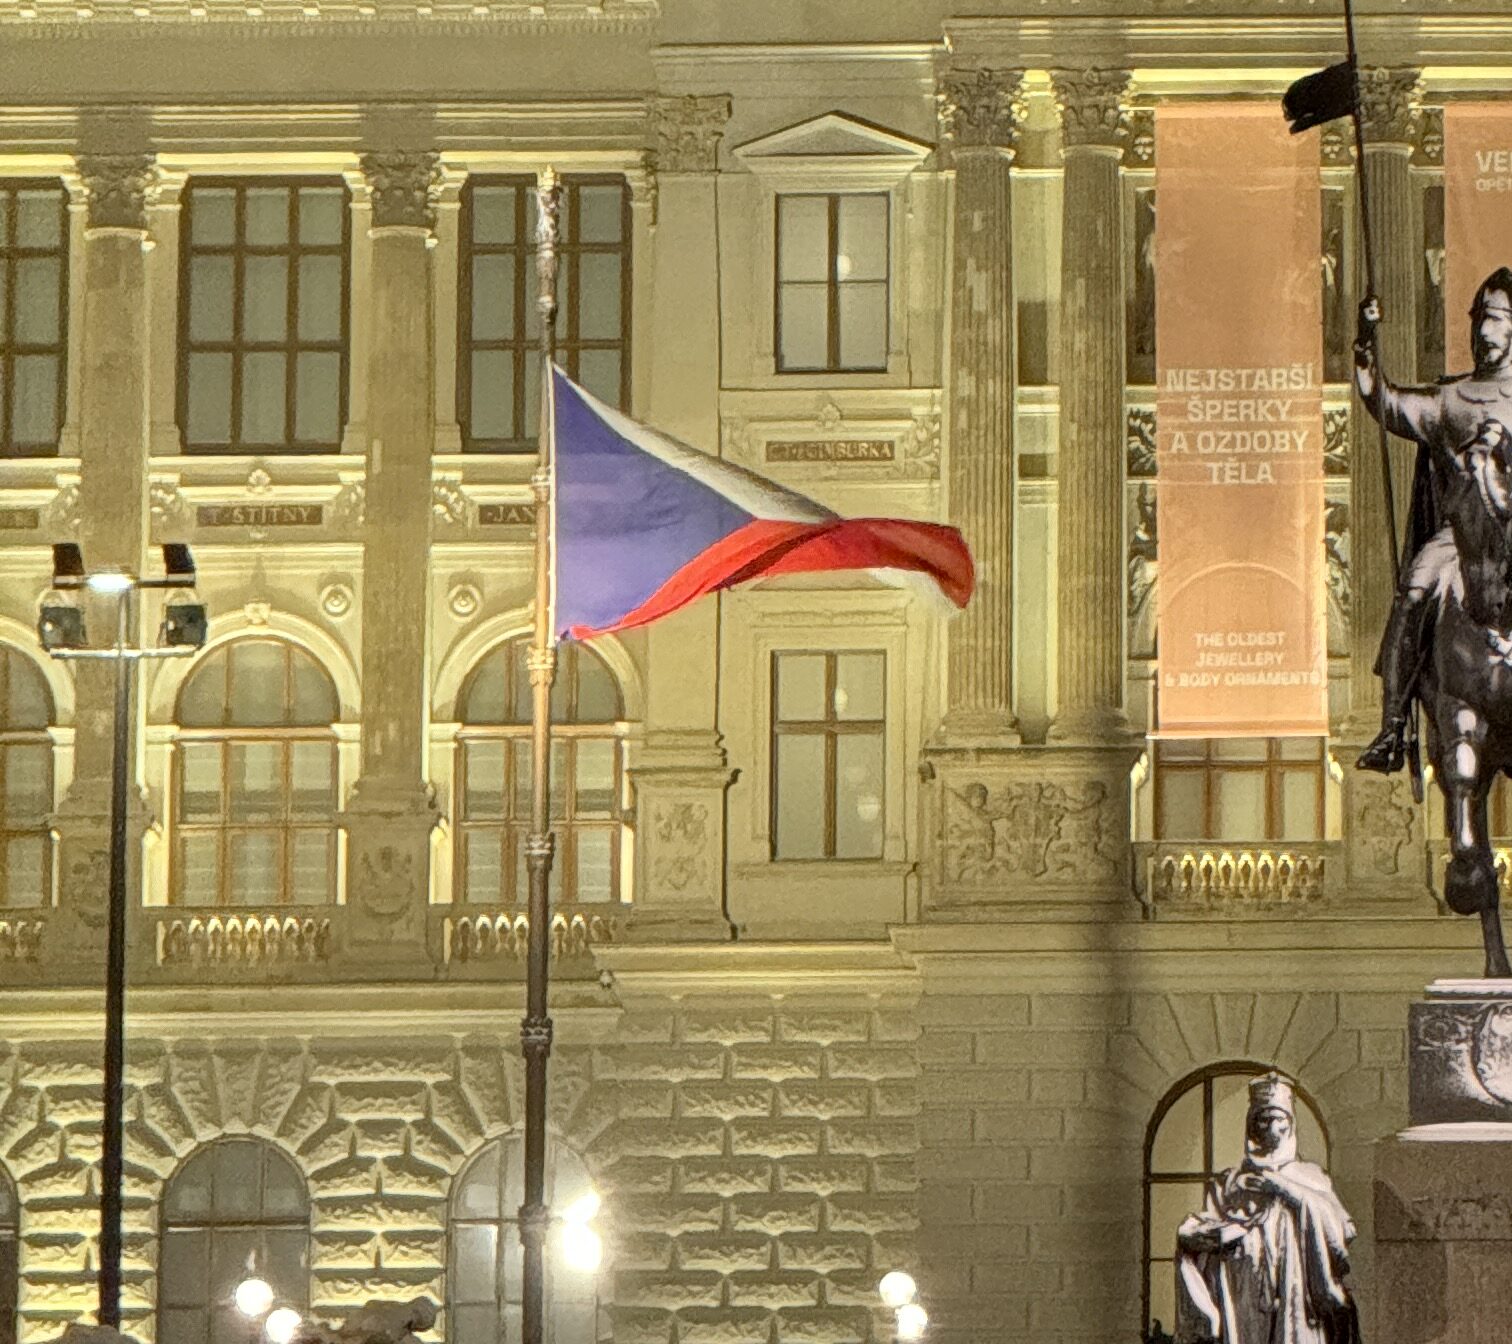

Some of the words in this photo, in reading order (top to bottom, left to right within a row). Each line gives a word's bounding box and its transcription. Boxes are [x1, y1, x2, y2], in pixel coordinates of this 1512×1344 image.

[1165, 363, 1314, 391] NEJSTARŠÍ
[1187, 395, 1293, 422] ŠPERKY
[1170, 431, 1189, 453] A
[1197, 430, 1309, 453] OZDOBY
[1206, 456, 1274, 484] TĚLA
[1195, 633, 1224, 647] THE
[1227, 631, 1286, 646] OLDEST
[1195, 651, 1286, 667] JEWELLERY
[1179, 672, 1221, 686] BODY
